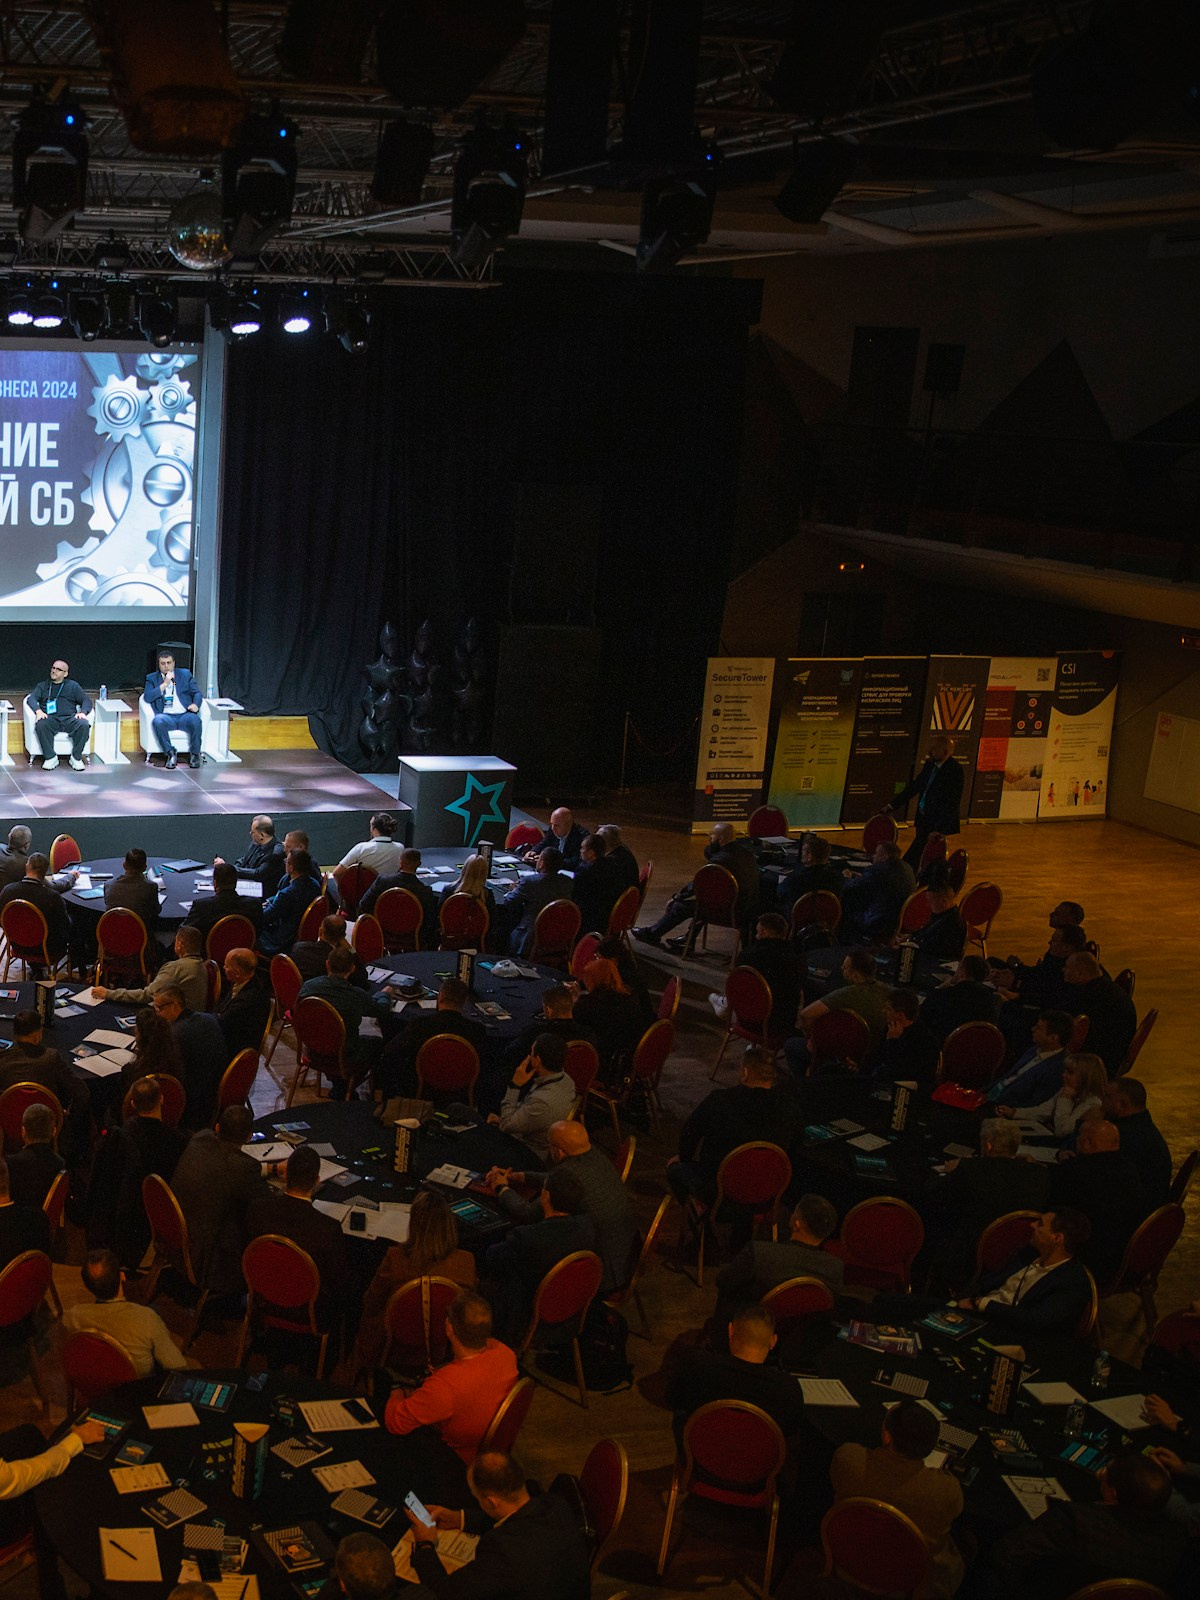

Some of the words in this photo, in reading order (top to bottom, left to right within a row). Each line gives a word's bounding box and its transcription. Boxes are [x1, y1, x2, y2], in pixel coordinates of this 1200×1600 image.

[41, 380, 78, 400] 2024
[30, 481, 75, 526] СБ
[1061, 663, 1077, 674] CSI
[712, 673, 768, 682] SecureTower
